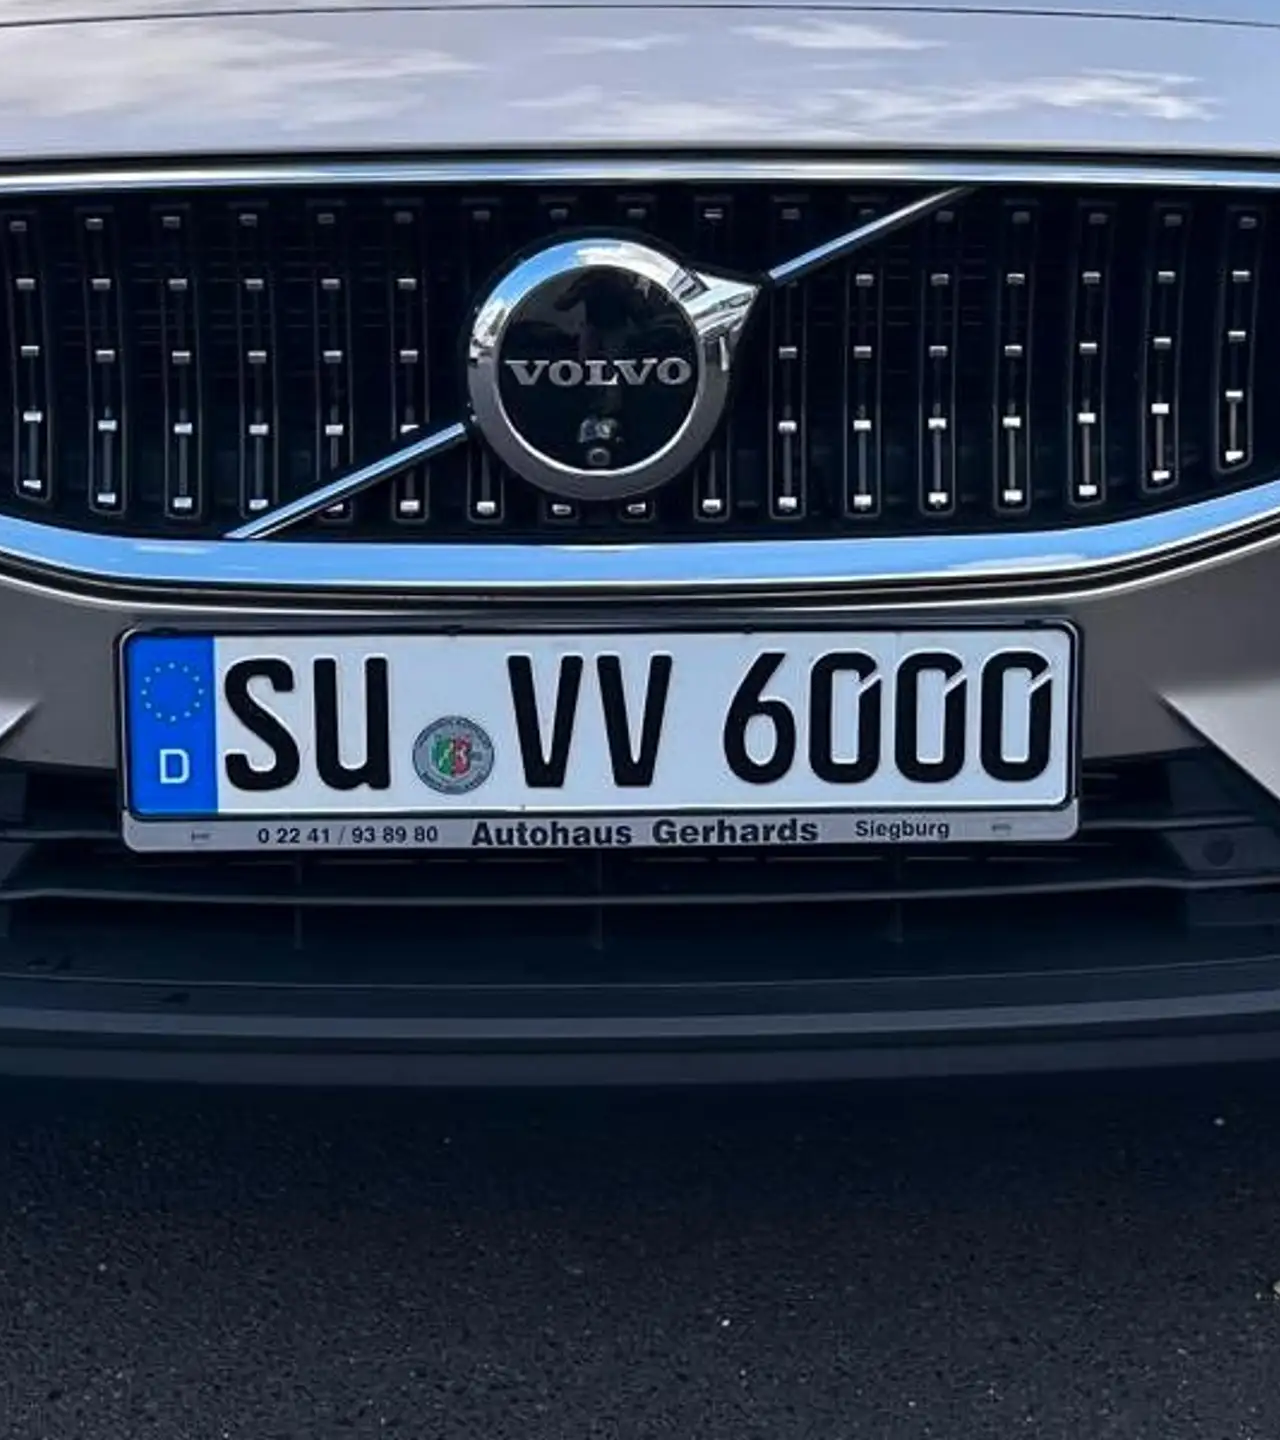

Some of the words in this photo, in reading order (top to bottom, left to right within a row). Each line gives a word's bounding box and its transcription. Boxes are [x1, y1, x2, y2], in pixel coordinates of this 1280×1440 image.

[504, 356, 692, 386] VOLVO
[223, 656, 392, 793] SU
[506, 654, 674, 789] VV
[722, 650, 1054, 786] 6000
[158, 747, 190, 785] D
[471, 819, 632, 848] Autohaus
[651, 817, 819, 846] Gerhards
[854, 818, 951, 841] Siegburg
